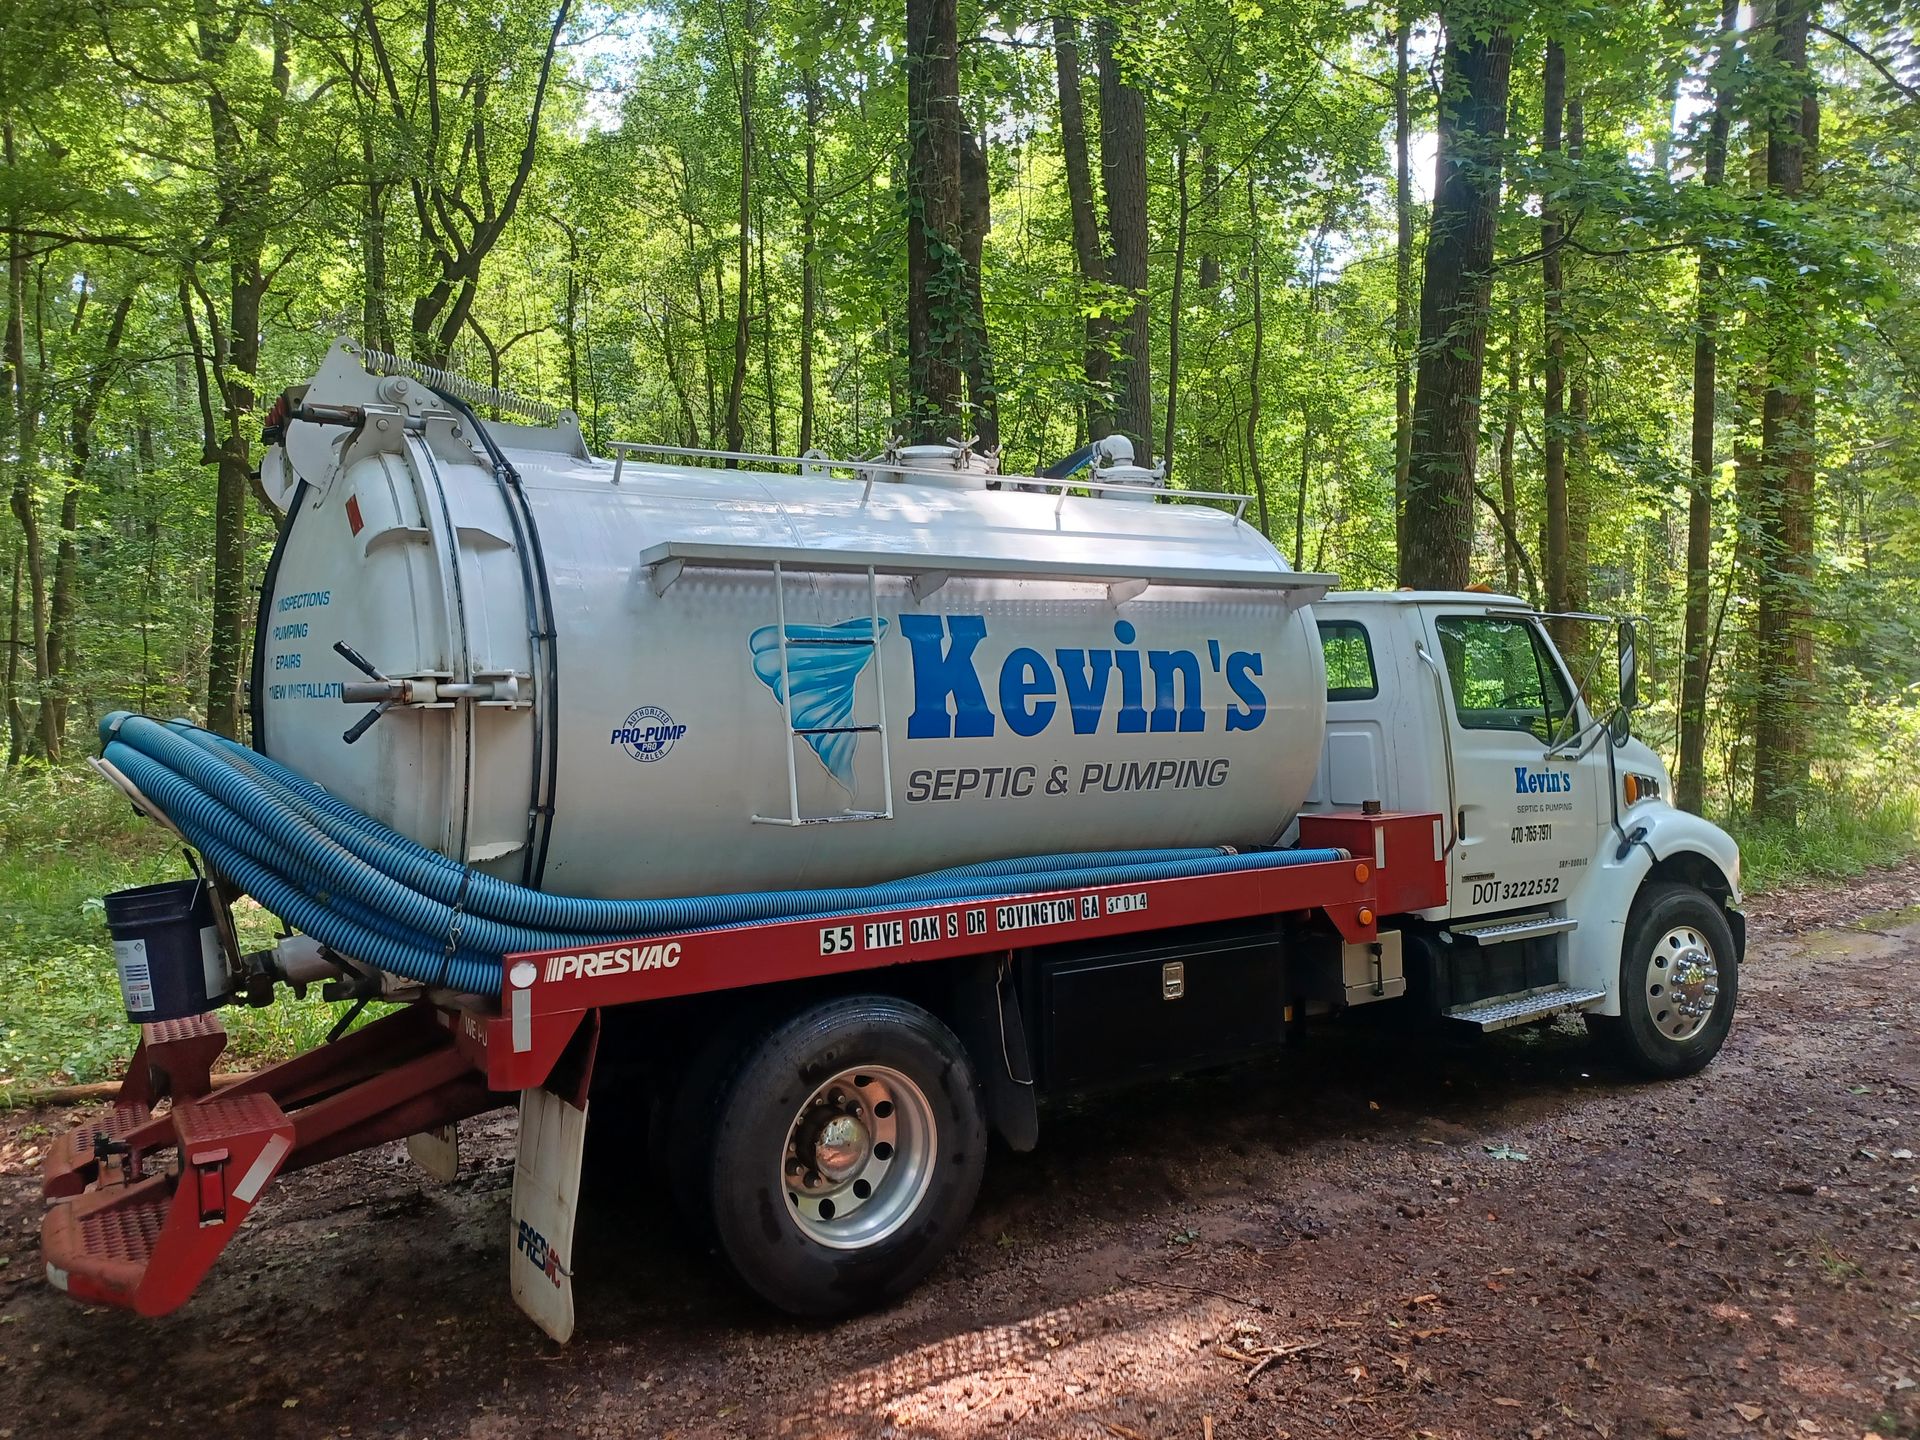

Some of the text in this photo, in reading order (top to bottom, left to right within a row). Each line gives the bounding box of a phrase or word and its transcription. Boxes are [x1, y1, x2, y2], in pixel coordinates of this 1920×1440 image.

[279, 591, 331, 613] INSPECTIONS
[274, 623, 308, 641] PUMPING
[274, 654, 301, 670] EPAIRS
[898, 614, 1267, 740] Kevin's
[288, 682, 342, 699] INSTALLATI
[627, 708, 670, 727] AUTHORIZED
[610, 725, 687, 745] PRO-PUMP
[634, 749, 665, 760] DEALER
[641, 742, 657, 752] PRO
[906, 758, 1230, 802] SEPTIC & PUMPING
[1514, 766, 1571, 794] Kevin's
[1517, 804, 1538, 814] SEPTIC
[1545, 802, 1573, 812] PUMPING
[1472, 881, 1502, 905] DOT
[1502, 877, 1560, 900] 3222552
[822, 926, 853, 954] 55
[865, 922, 902, 949] FIVE
[966, 910, 987, 935] DR
[997, 898, 1075, 930] COVINGTON
[1081, 896, 1099, 918] GA
[545, 943, 681, 983] PRESVAC
